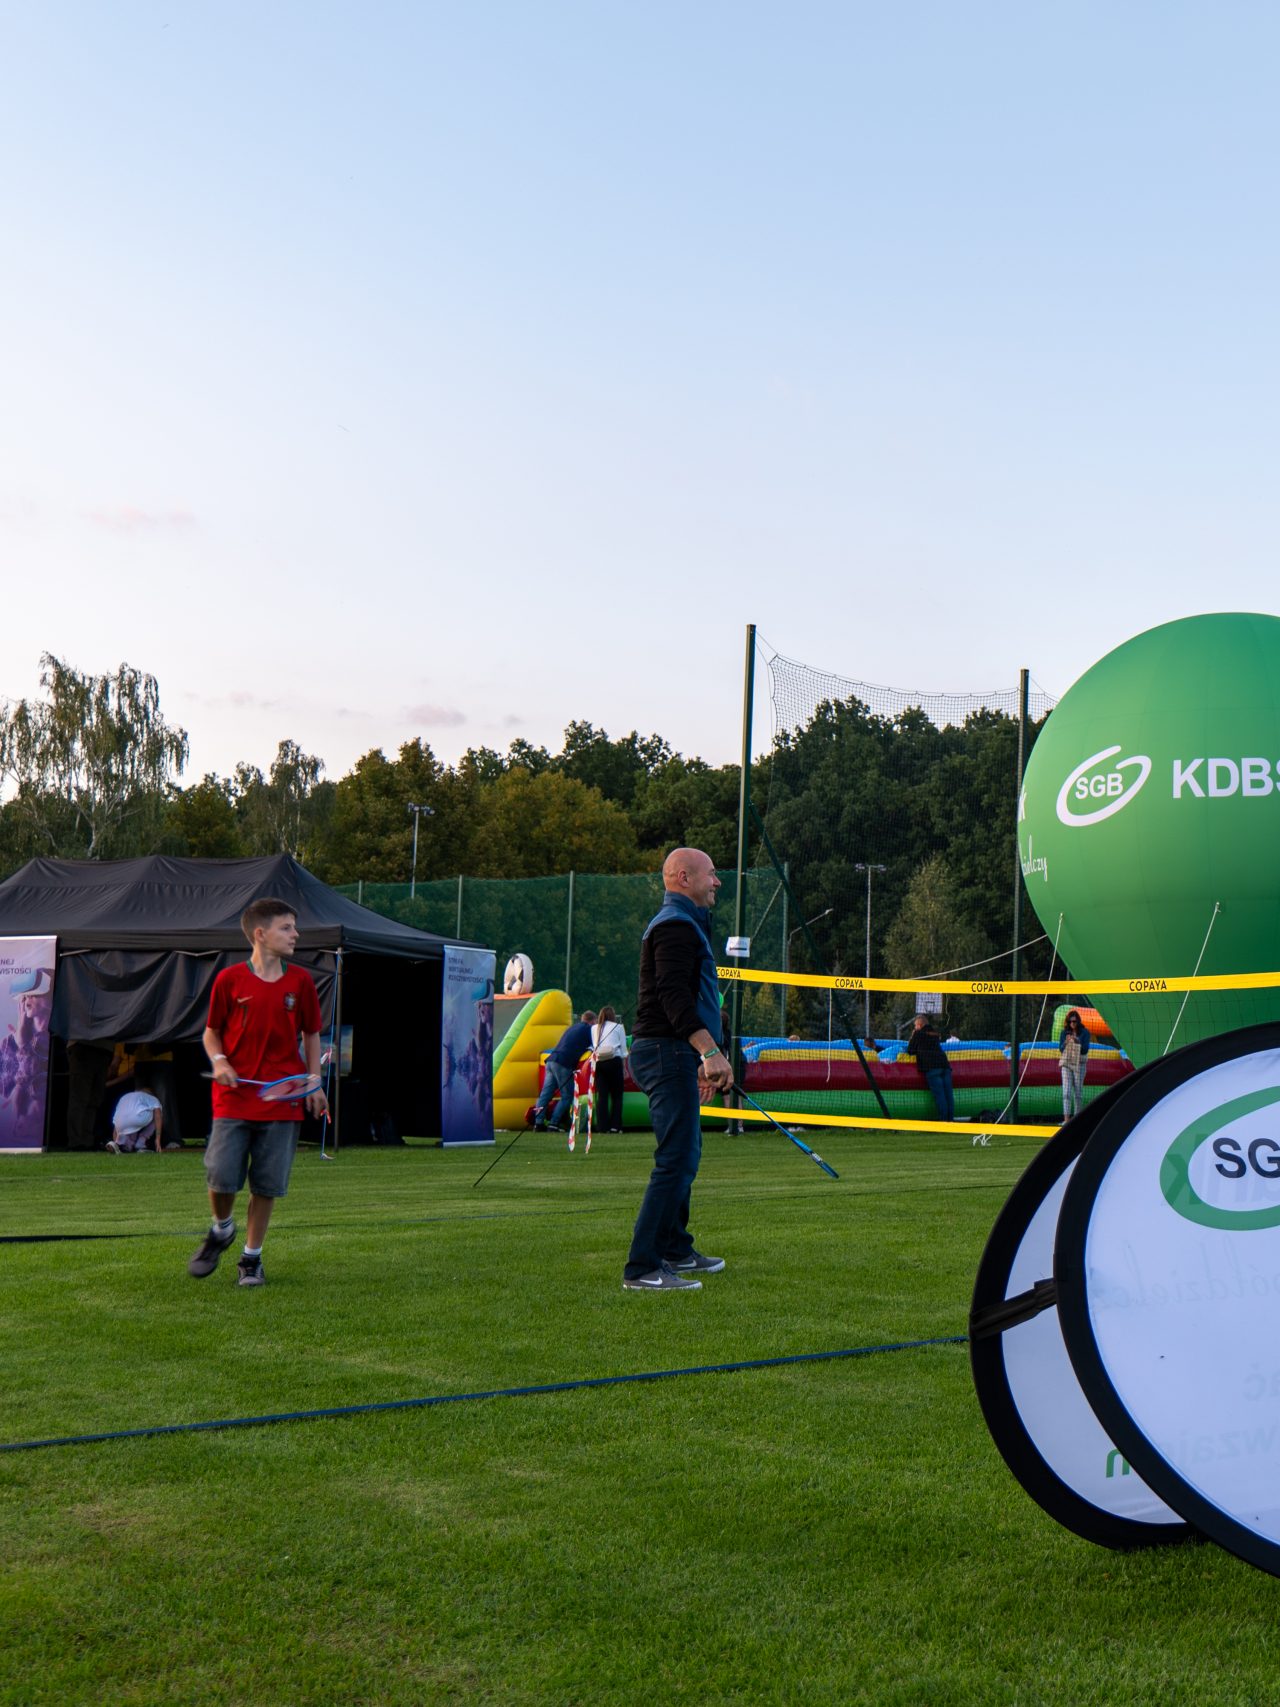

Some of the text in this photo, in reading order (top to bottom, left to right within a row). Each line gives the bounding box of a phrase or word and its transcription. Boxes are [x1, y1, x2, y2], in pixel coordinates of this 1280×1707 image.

[1075, 773, 1123, 799] SGB
[716, 967, 741, 979] COPAYA
[835, 978, 864, 989] COPAYA
[971, 982, 1004, 993] COPAYA
[1129, 979, 1168, 992] COPAYA
